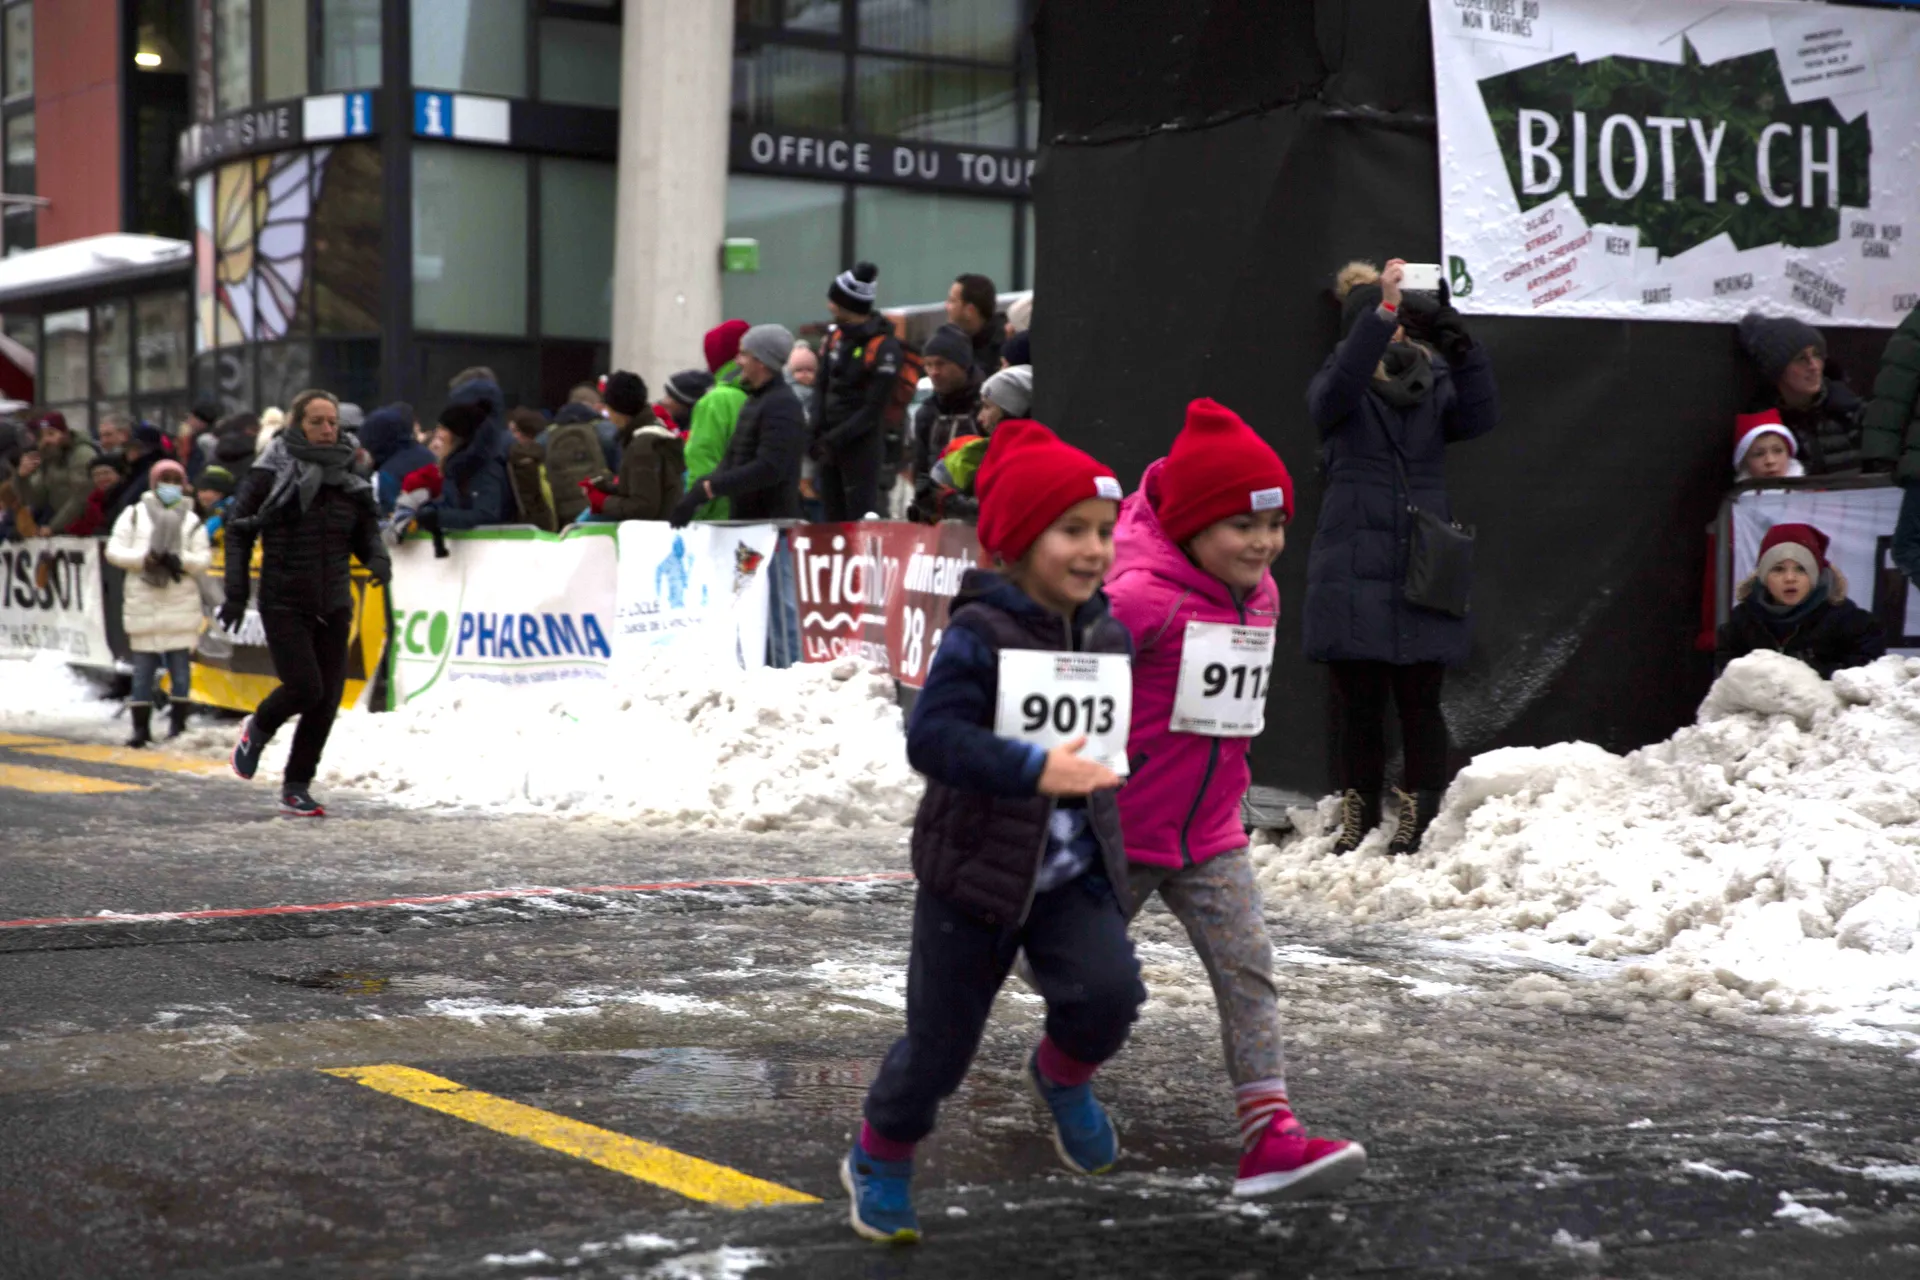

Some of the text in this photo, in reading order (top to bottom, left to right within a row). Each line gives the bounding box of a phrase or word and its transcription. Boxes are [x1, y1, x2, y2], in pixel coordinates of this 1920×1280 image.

[750, 133, 870, 173] OFFICE
[893, 147, 939, 179] DU
[1518, 107, 1840, 209] BIOTY.CH
[1606, 236, 1631, 256] NEEM
[1714, 272, 1753, 295] MORINGA
[0, 549, 85, 613] ISSOT
[456, 611, 612, 659] PHARMA
[1022, 692, 1116, 735] 9013
